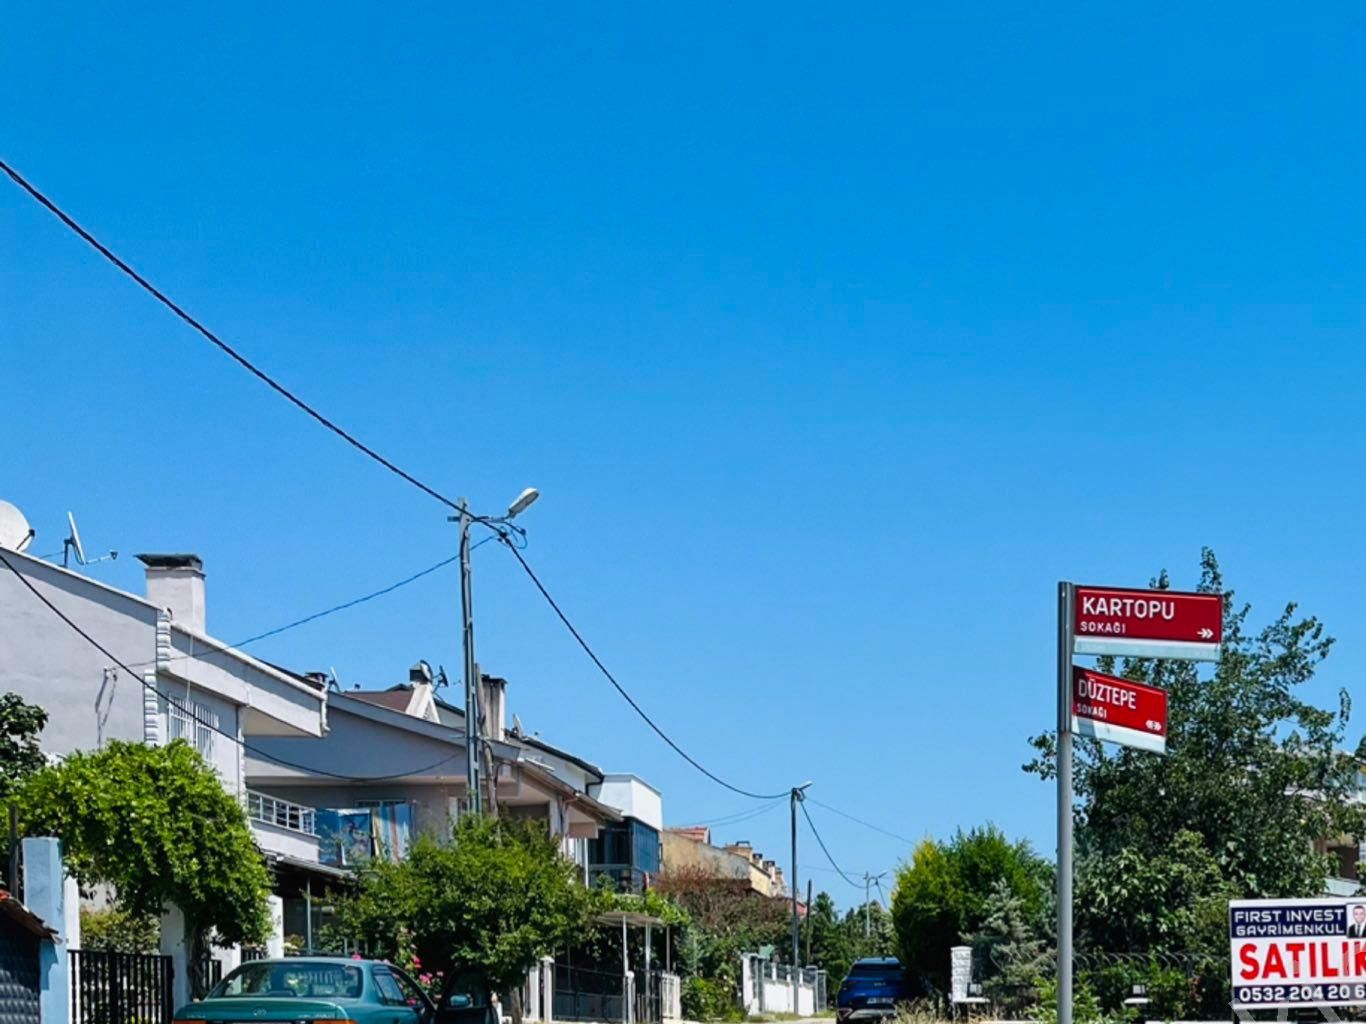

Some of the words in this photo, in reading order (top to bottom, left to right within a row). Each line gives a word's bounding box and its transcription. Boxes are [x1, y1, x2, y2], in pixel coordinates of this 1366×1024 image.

[1082, 596, 1175, 620] KARTOPU
[1080, 621, 1126, 633] SOKAĞI
[1078, 678, 1136, 709] DÜZTEPE
[1077, 703, 1107, 719] SOKAĞI
[1234, 911, 1282, 923] FIRST
[1286, 909, 1344, 921] INVEST
[1236, 922, 1345, 936] GAYRİMENKUL
[1240, 987, 1285, 1002] 0532
[1289, 986, 1324, 1000] 204
[1328, 985, 1351, 999] 20
